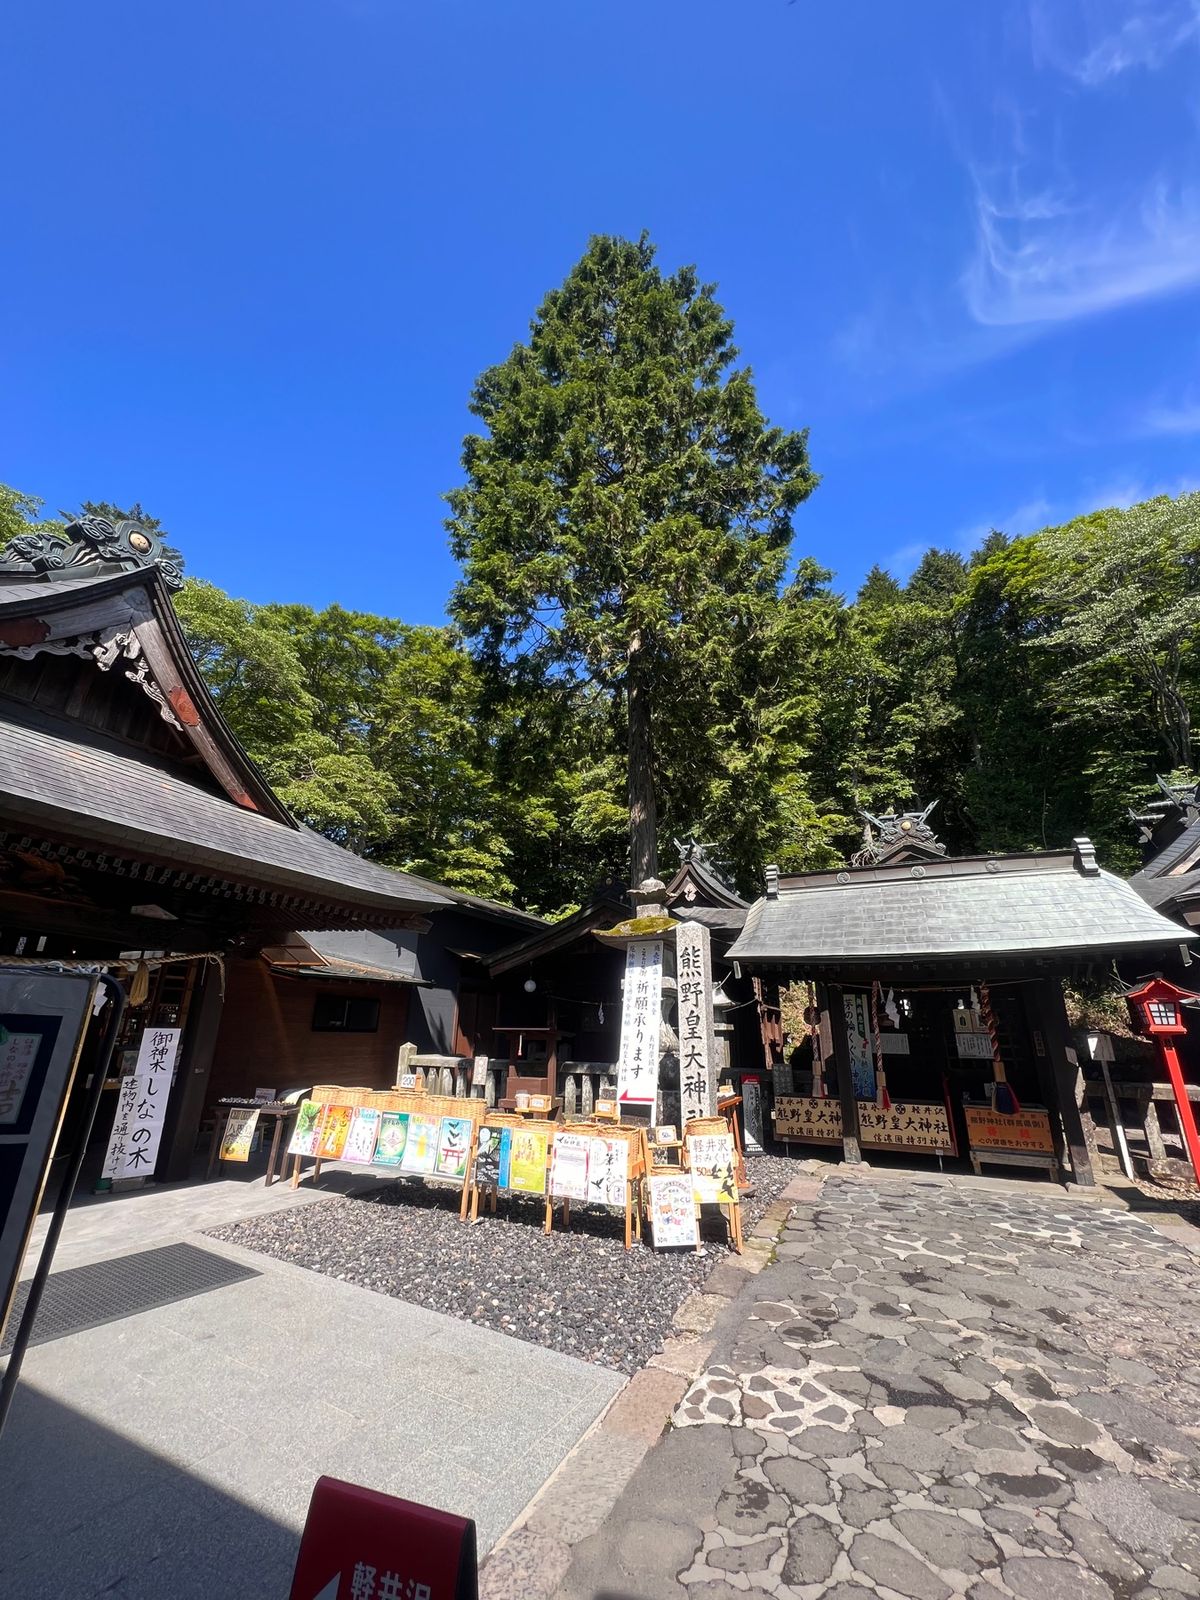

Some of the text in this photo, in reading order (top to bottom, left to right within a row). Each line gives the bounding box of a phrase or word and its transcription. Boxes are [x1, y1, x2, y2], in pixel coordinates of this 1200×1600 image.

[912, 1106, 945, 1115] 軽井沢
[108, 1078, 139, 1175] 建物内を通り抜けて
[860, 1113, 949, 1134] 熊野皇大神社
[693, 1139, 729, 1153] 軽井沢
[695, 1153, 729, 1164] おみくじ
